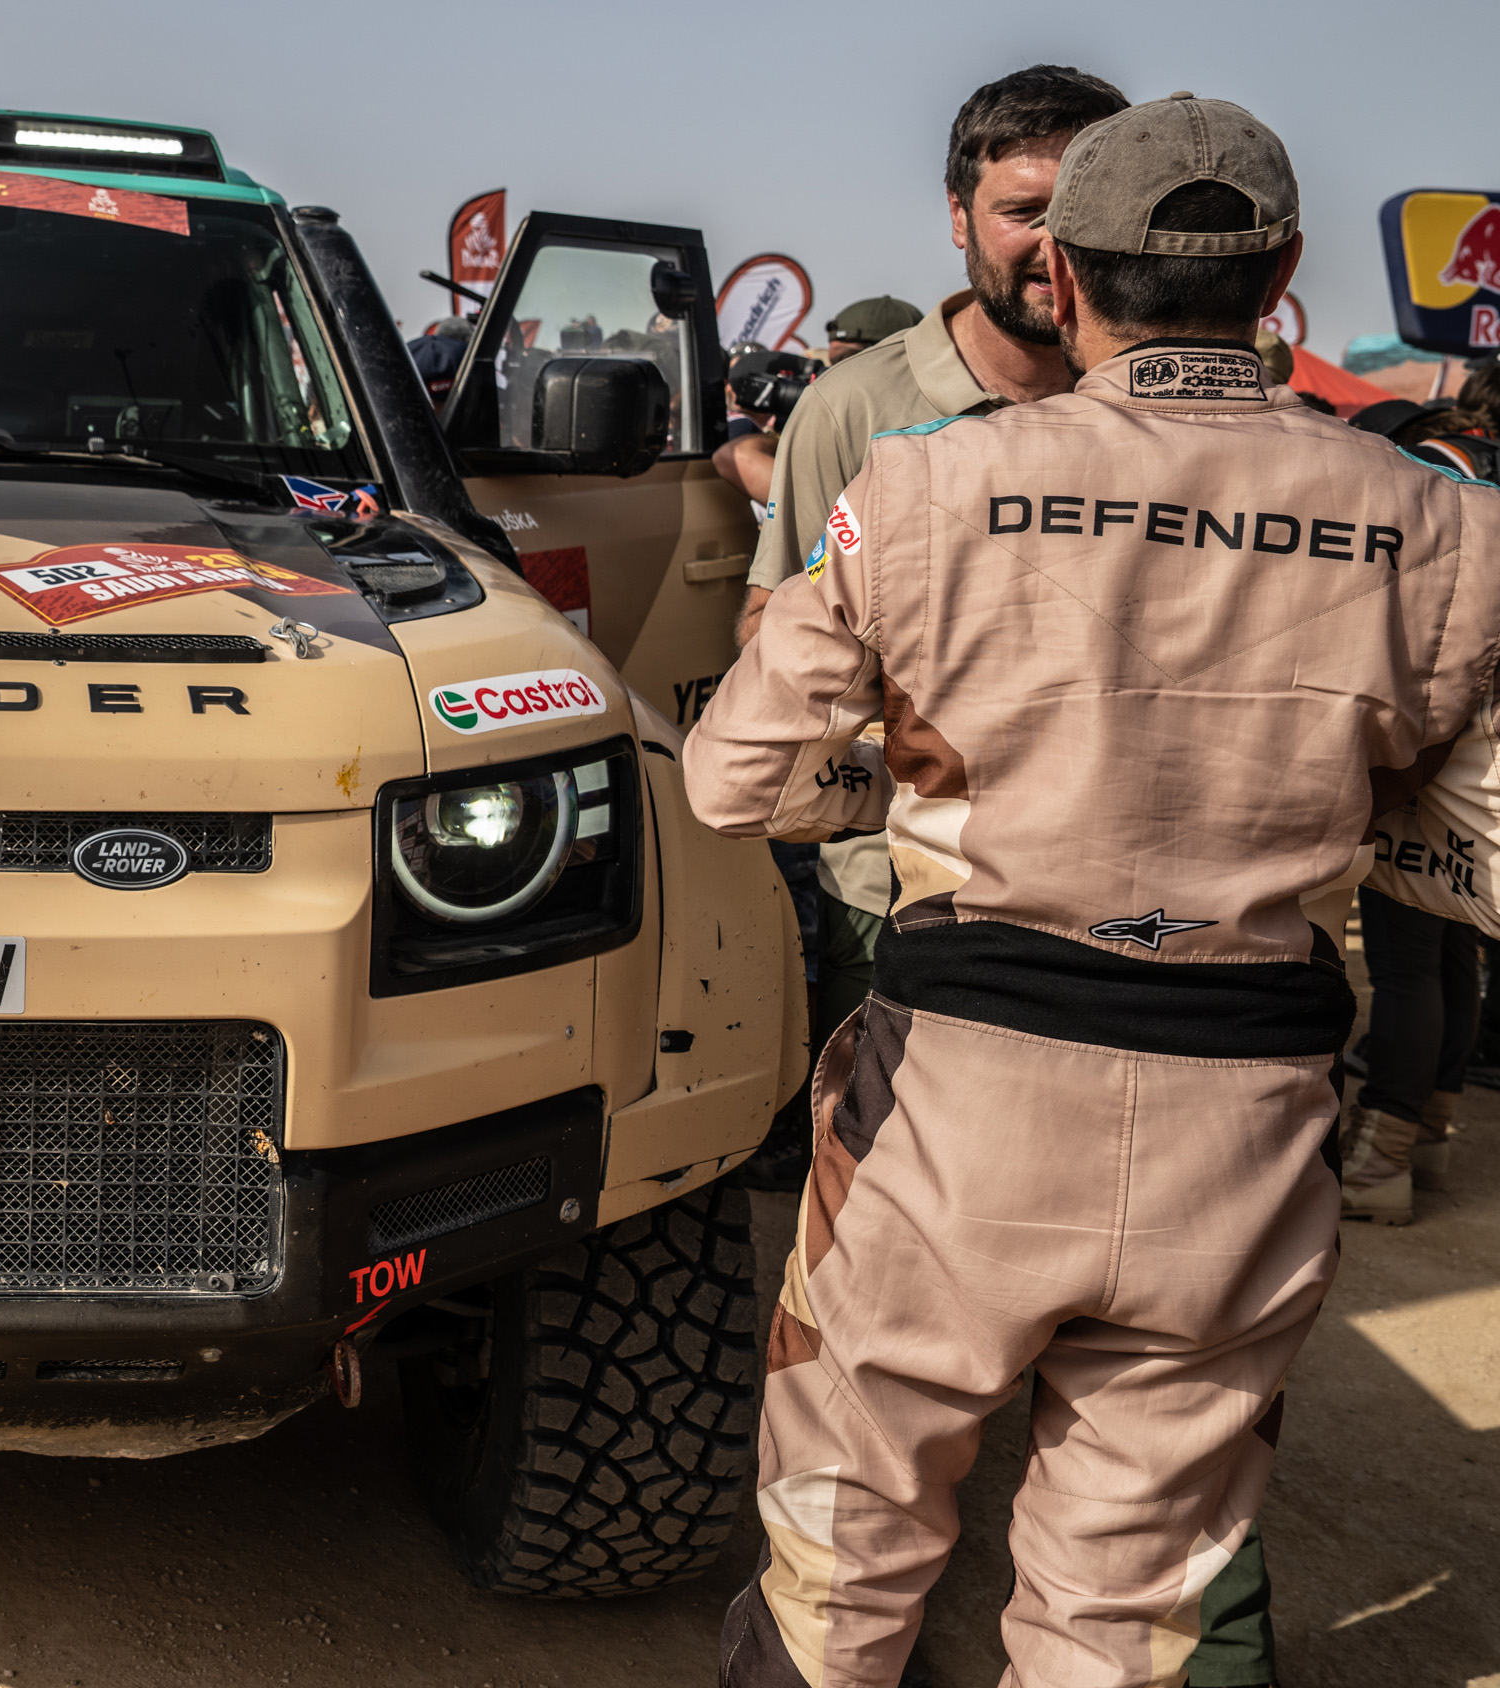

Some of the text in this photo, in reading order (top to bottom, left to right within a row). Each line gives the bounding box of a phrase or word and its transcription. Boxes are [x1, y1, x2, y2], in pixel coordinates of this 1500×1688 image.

[1180, 354, 1217, 364] Standard
[1153, 389, 1174, 397] valid
[988, 495, 1405, 571] DEFENDER
[27, 564, 111, 586] 502
[79, 572, 179, 602] SAUDI
[474, 675, 600, 720] Castrol
[348, 1248, 427, 1304] TOW
